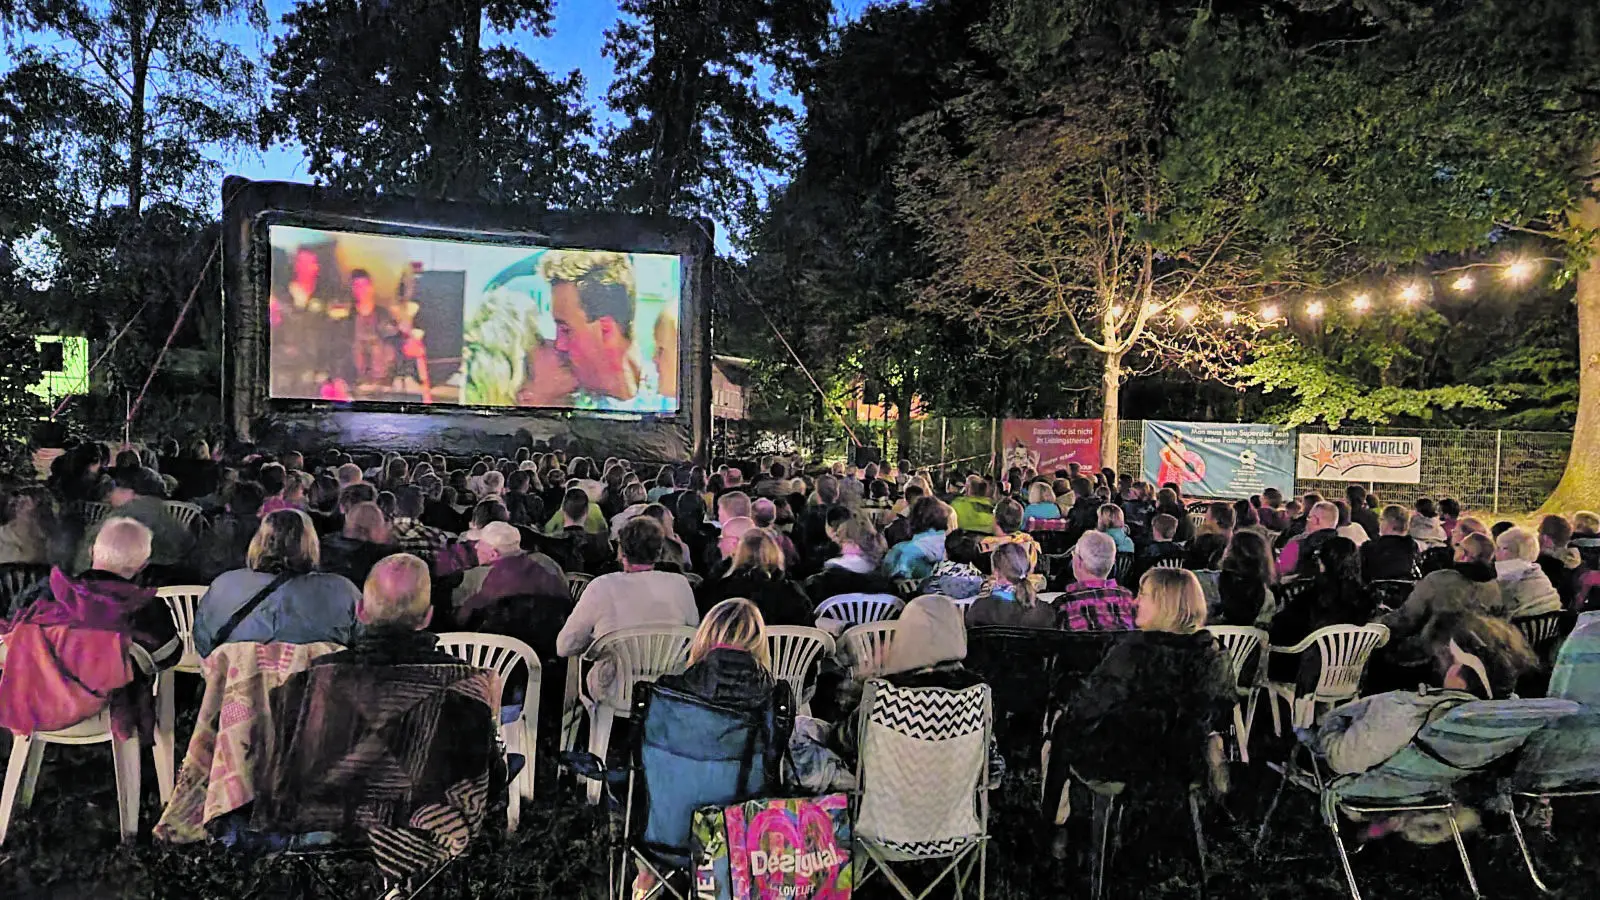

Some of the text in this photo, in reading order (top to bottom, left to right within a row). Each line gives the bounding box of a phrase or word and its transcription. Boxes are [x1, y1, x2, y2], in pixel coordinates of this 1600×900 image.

[1191, 428, 1206, 436] Man
[1333, 439, 1410, 455] MOVIEWORLD
[778, 886, 800, 897] LOVE
